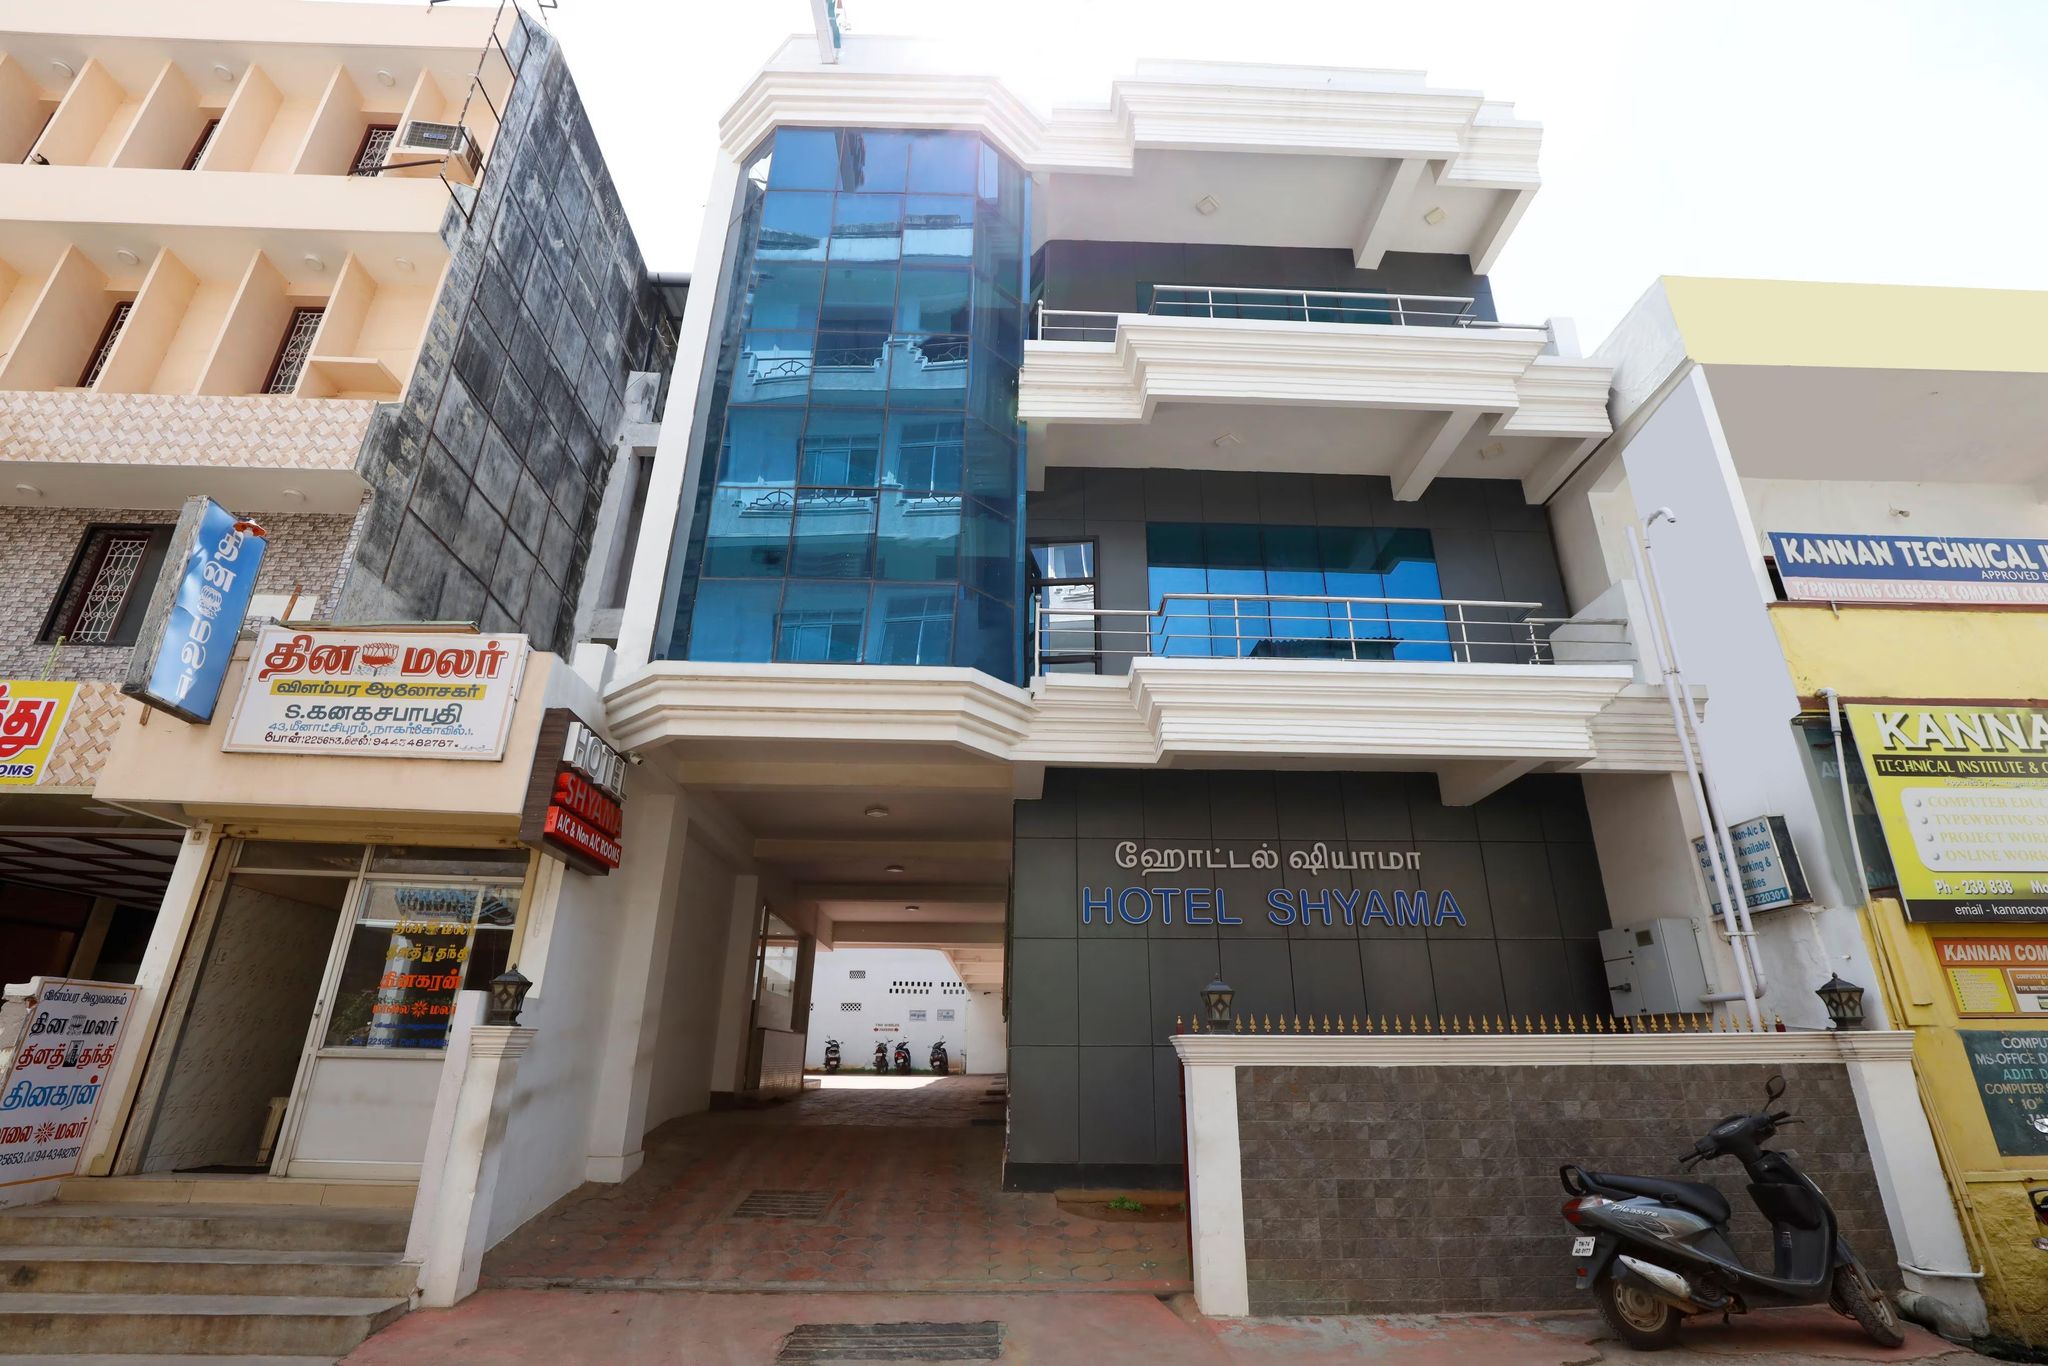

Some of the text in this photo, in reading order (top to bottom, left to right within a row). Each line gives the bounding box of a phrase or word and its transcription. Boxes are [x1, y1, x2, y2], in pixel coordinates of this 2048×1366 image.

[1780, 537, 1894, 566] KANNAN
[1894, 540, 2040, 569] TECHNICAL
[1981, 570, 2040, 581] APPROVED
[1794, 581, 1883, 597] TYPEWRITING
[1952, 585, 2019, 600] COMPUTER
[259, 634, 509, 681] தின மலர்
[277, 680, 480, 699] விளம்பர ஆலோசகர்
[563, 721, 627, 800] HOTEL
[1877, 759, 1954, 773] TECHNICAL
[1957, 760, 2026, 774] INSTITUTE
[2029, 761, 2040, 774] &
[556, 772, 623, 838] SHYAMA
[1927, 796, 2008, 808] COMPUTER
[1759, 822, 1766, 833] &
[1935, 813, 2034, 826] TYPEWRITING
[557, 814, 621, 864] A/C & Non A/C ROOMS
[1939, 832, 2002, 844] PROJECT
[1739, 840, 1771, 857] Available
[1945, 850, 2002, 862] ONLINE
[1114, 841, 1422, 876] ஹோட்டல் ஷியாமா
[1765, 856, 1772, 867] &
[1935, 880, 1953, 894] Ph
[1962, 880, 1987, 895] 238
[1989, 880, 2014, 895] 838
[1082, 886, 1467, 928] HOTEL SHYAMA
[1955, 904, 1984, 915] email
[1943, 945, 2011, 961] KANNAN
[29, 1011, 119, 1037] தின மலர்
[2001, 1037, 2048, 1049] COMPU
[15, 1042, 116, 1070] தினத் தந்தி
[0, 1075, 100, 1111] தினகரன்
[54, 1117, 88, 1139] மலர்
[1610, 1203, 1659, 1217] Pleasure
